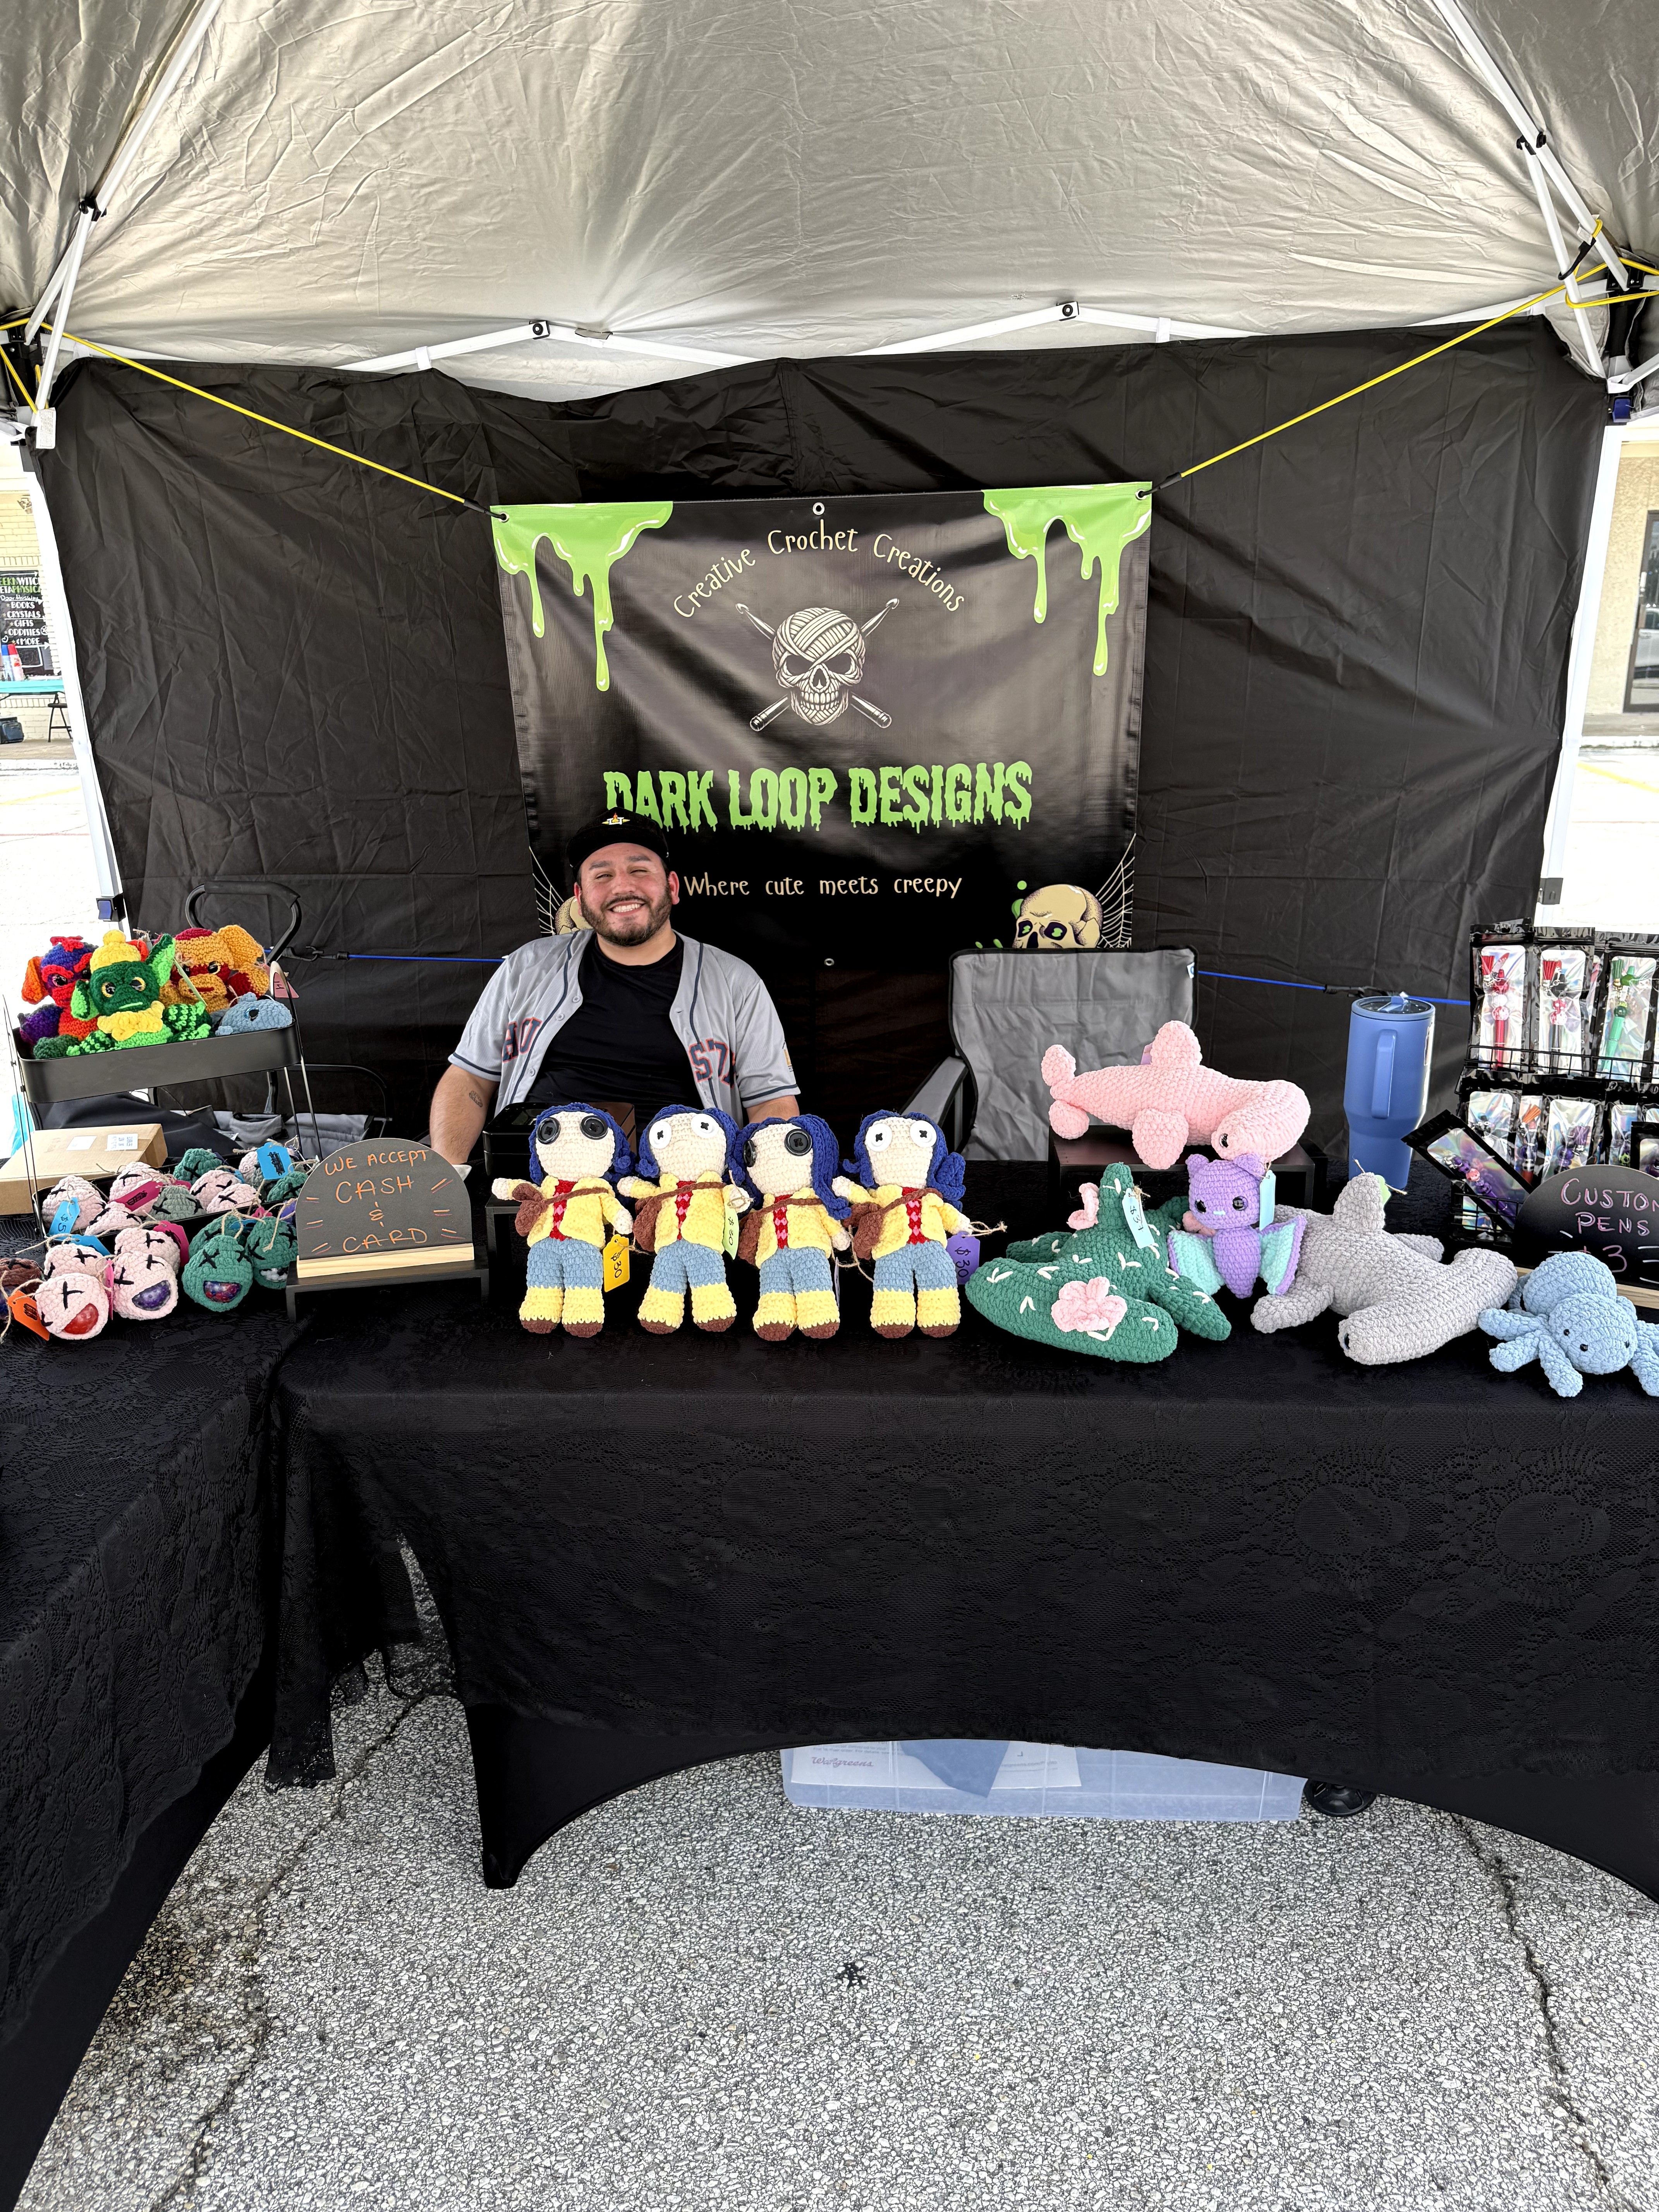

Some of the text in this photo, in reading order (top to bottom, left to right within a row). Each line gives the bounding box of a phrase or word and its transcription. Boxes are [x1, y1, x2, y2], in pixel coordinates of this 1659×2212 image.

[674, 519, 964, 617] Creative Crochet Creations
[603, 761, 1032, 834] DARK LOOP DESIGNS
[684, 872, 962, 898] Where cute meets creepy
[325, 1149, 429, 1176] WE ACCEPT
[336, 1175, 414, 1204] CASH
[58, 1213, 69, 1232] $5
[1575, 1212, 1650, 1237] PENS
[343, 1228, 428, 1253] CARD
[611, 1251, 622, 1278] $30
[954, 1246, 971, 1278] $30
